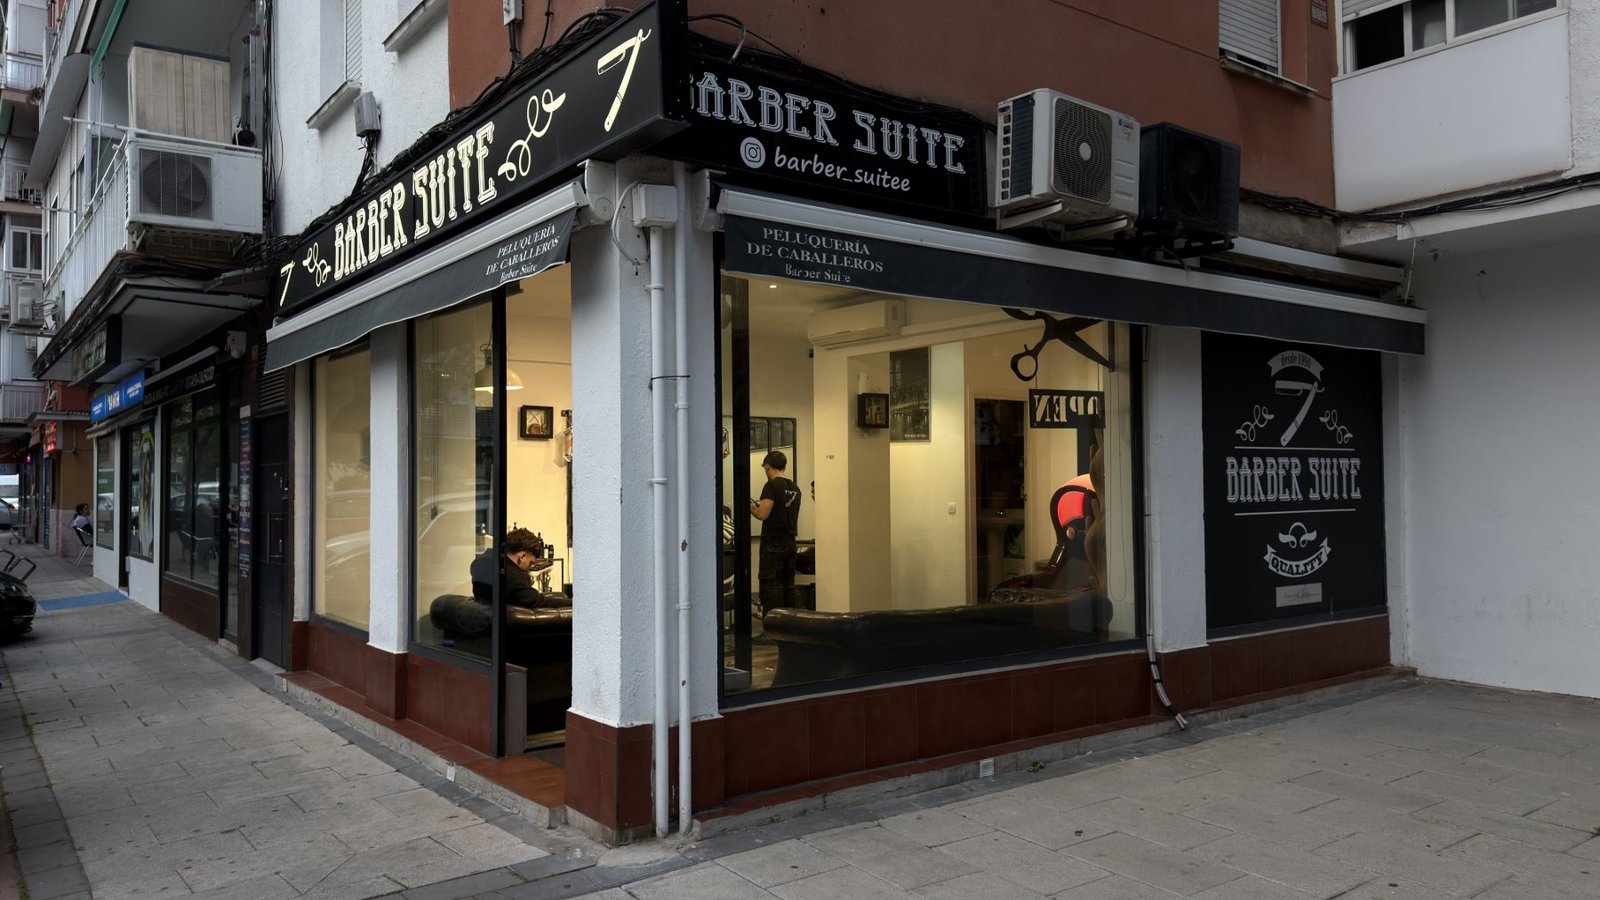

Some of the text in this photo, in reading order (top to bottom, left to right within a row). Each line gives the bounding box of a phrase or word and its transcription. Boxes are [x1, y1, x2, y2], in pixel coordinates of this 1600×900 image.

[689, 71, 966, 175] ARBER SUITE
[774, 146, 911, 192] barber_suitee
[334, 121, 498, 281] BARBER SUITE
[486, 236, 560, 276] DE CABALLEROS
[497, 223, 555, 258] PELUQUERÍA
[747, 242, 884, 273] DE CABALLEROS
[762, 226, 871, 255] PELUQUERÍA
[824, 269, 851, 283] Suie
[1226, 456, 1362, 504] BARBER SUITE
[1271, 551, 1323, 576] QUALITY
